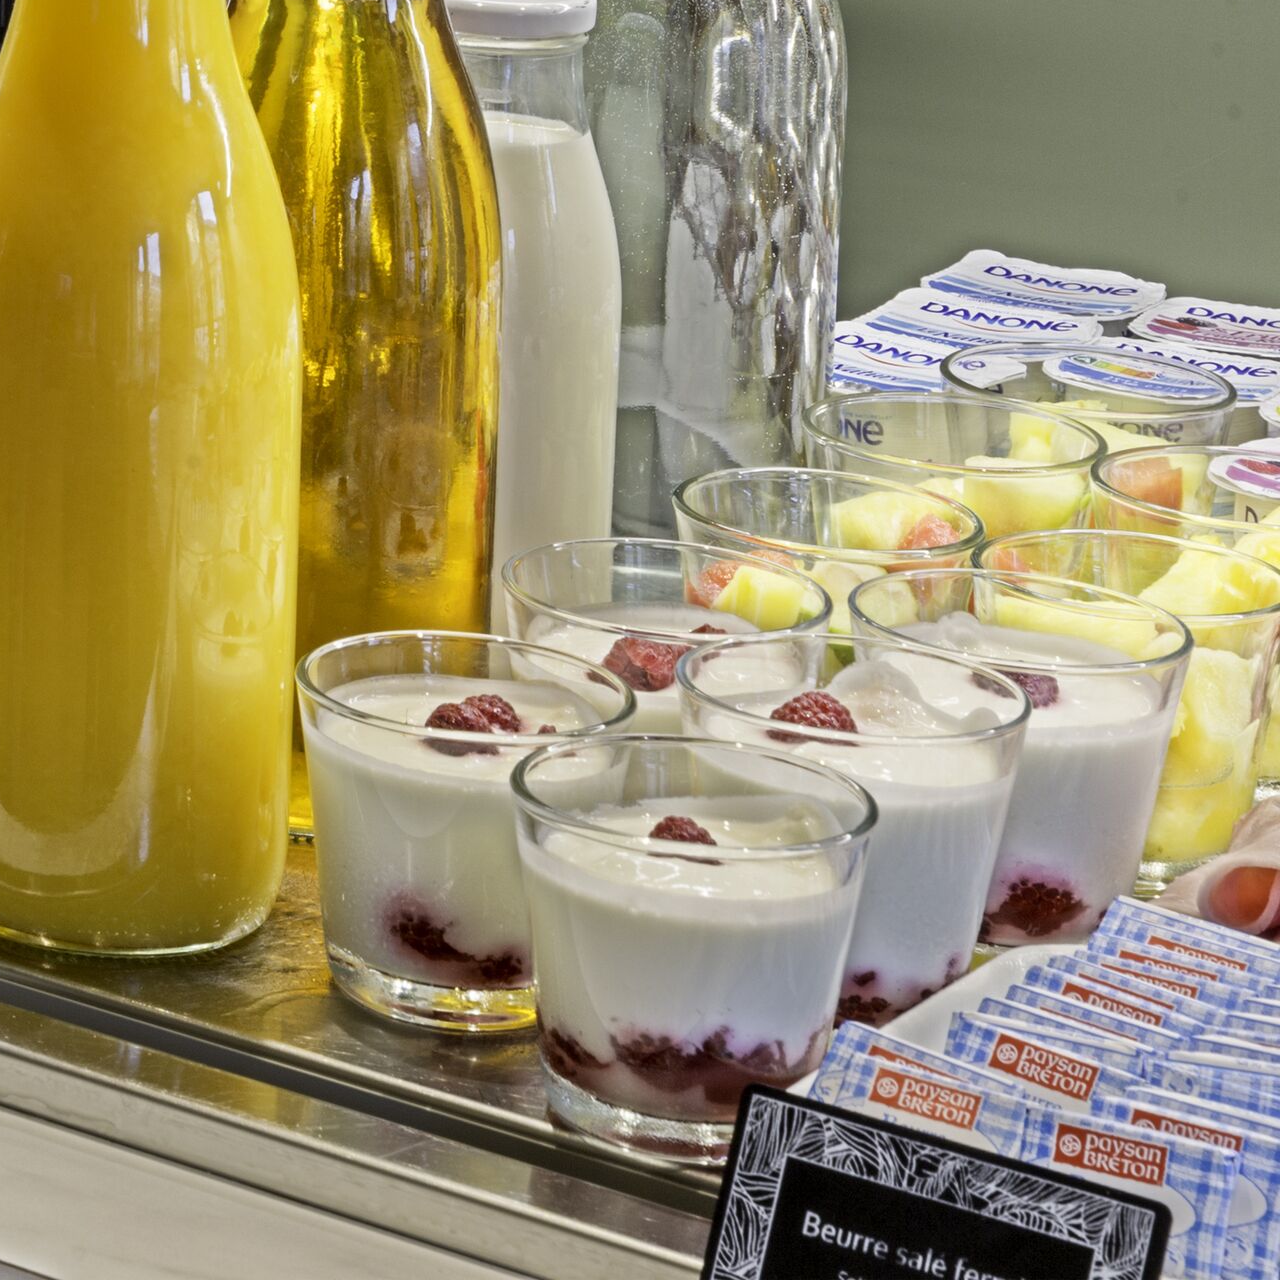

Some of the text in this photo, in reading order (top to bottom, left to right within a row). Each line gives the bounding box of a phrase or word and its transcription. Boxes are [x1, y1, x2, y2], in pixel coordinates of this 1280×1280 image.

[984, 265, 1138, 297] DANONE
[920, 301, 1079, 332] DANONE
[1186, 307, 1280, 328] DAN
[1016, 1061, 1087, 1097] BRETON
[1020, 1045, 1093, 1081] Paysan
[898, 1093, 971, 1125] BRETON
[903, 1078, 976, 1111] Paysan
[1085, 1134, 1162, 1164] Paysan
[1083, 1151, 1160, 1181] BRETON
[802, 1210, 889, 1259] Beurre
[896, 1247, 947, 1277] salé
